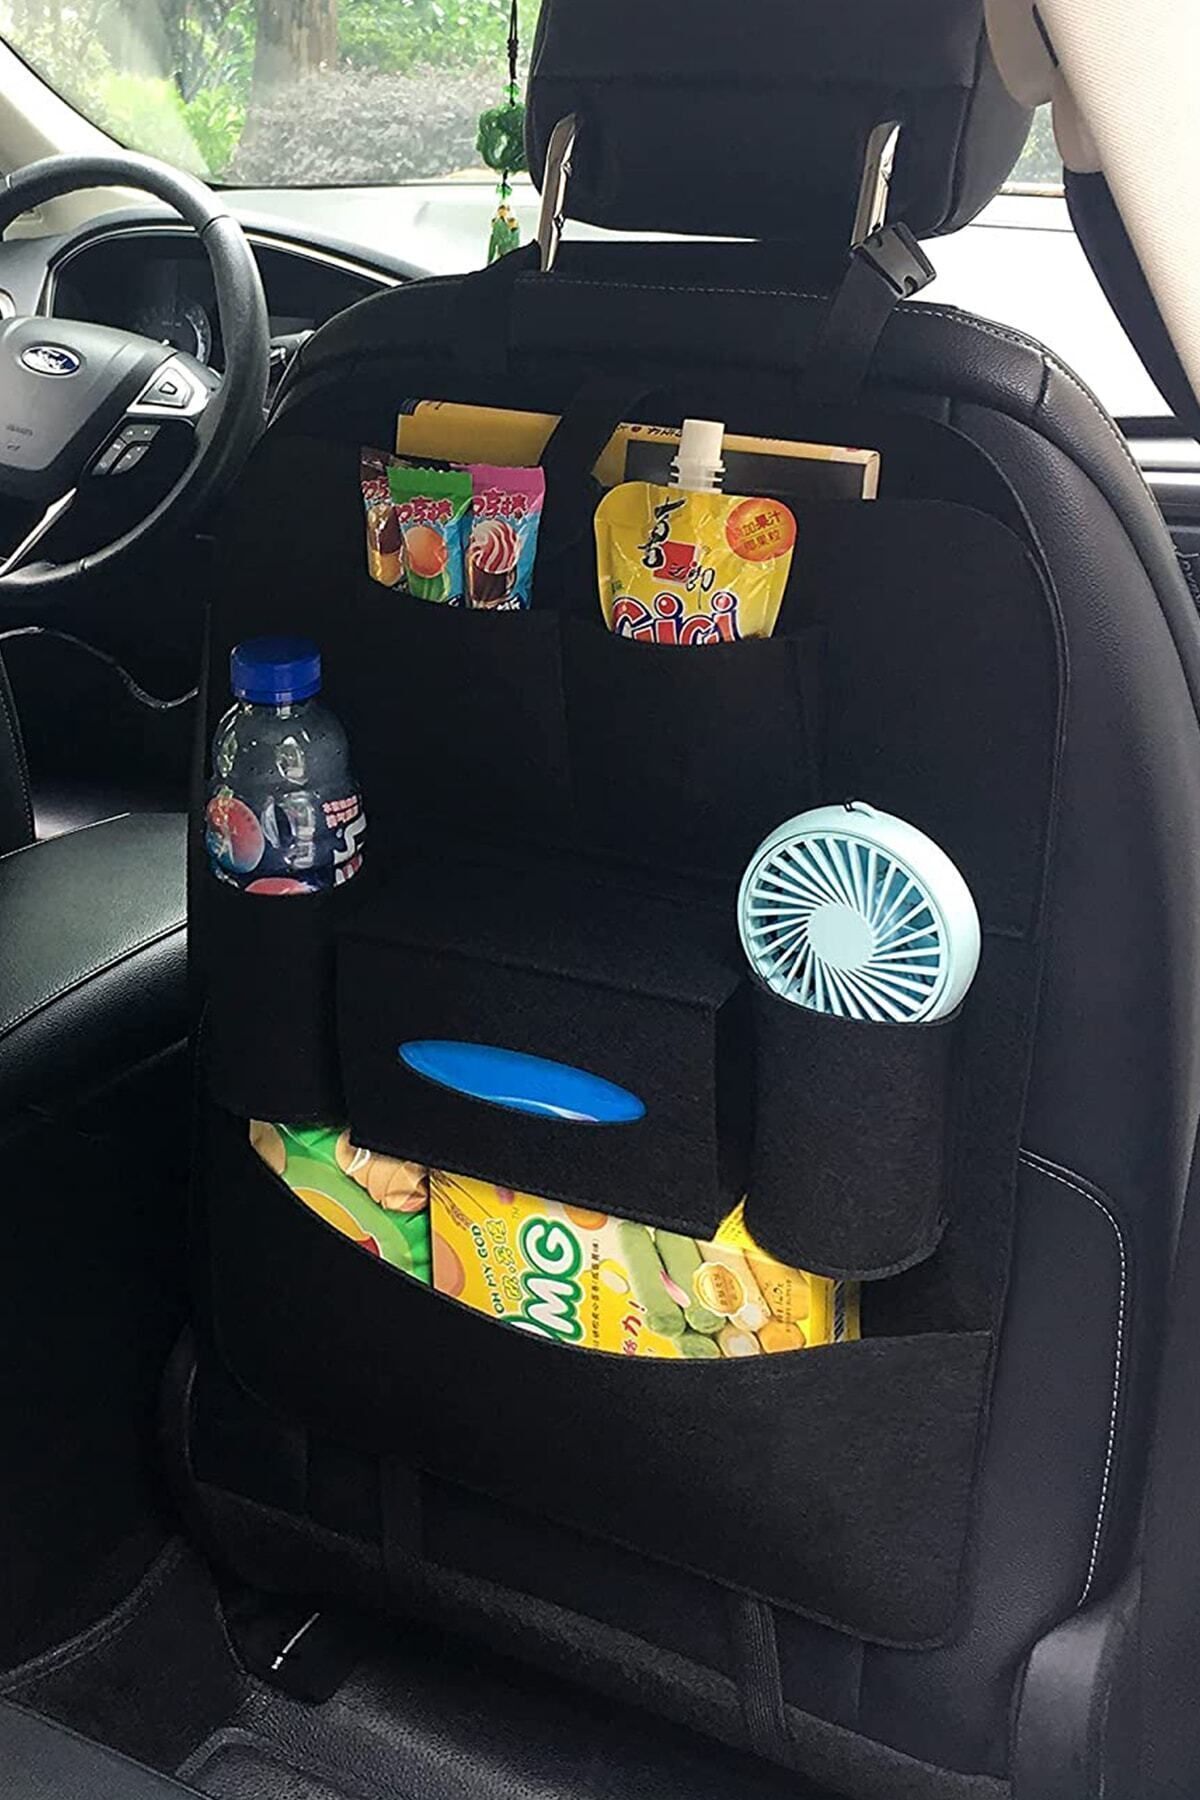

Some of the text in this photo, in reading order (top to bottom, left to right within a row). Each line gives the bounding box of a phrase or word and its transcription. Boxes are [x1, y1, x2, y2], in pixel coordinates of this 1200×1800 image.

[471, 1225, 505, 1314] OH MY GOD
